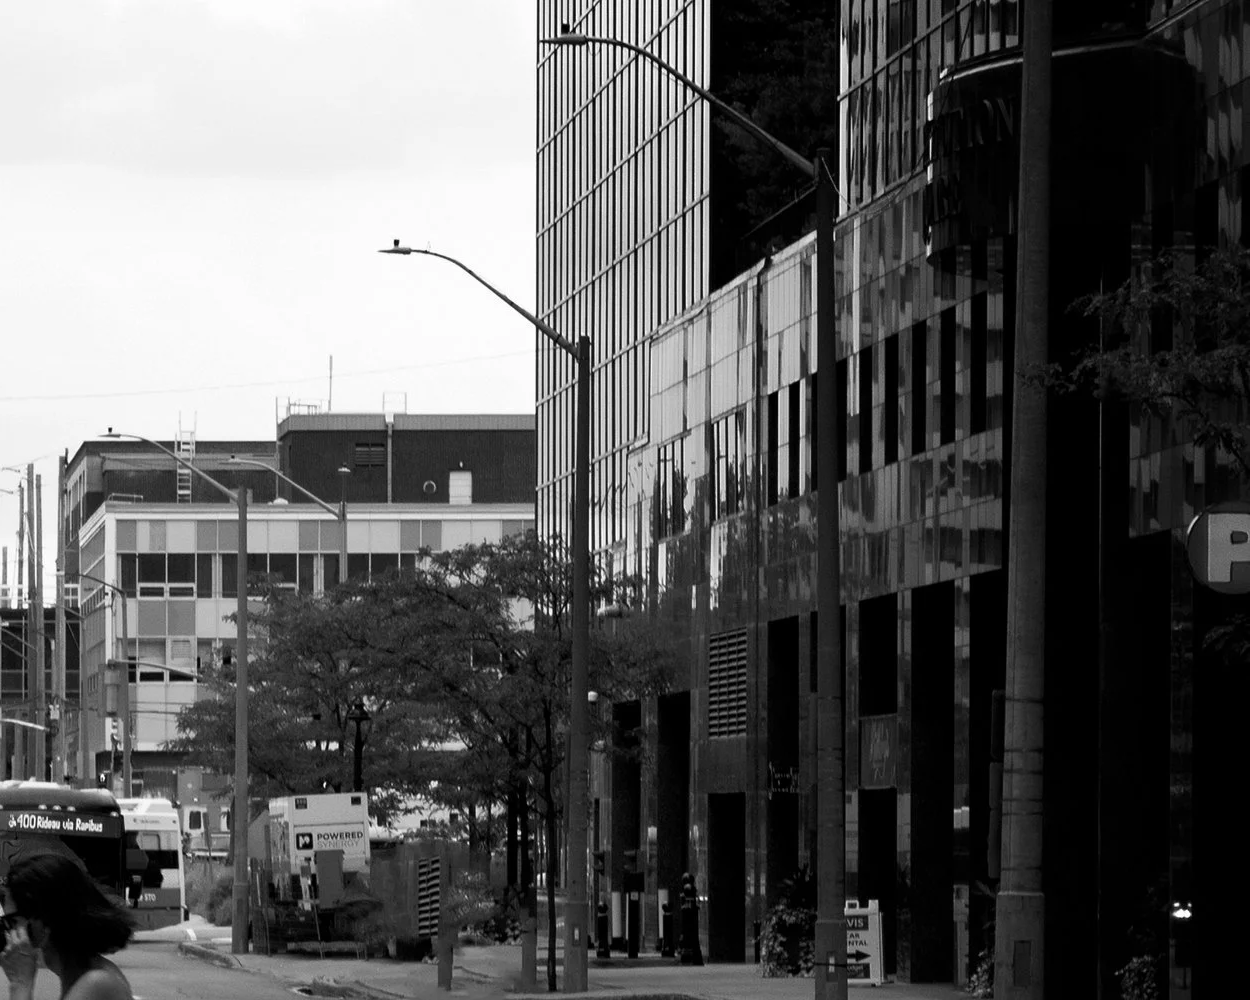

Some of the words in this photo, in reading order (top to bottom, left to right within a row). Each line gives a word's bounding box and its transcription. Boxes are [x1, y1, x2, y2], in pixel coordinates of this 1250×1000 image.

[1207, 513, 1250, 582] P
[17, 814, 36, 829] 400
[37, 815, 61, 830] Rideau
[62, 818, 74, 831] via
[75, 817, 103, 833] Rapibus
[317, 831, 363, 841] POWERED
[317, 839, 359, 849] SYNERGY
[847, 918, 864, 928] VIS
